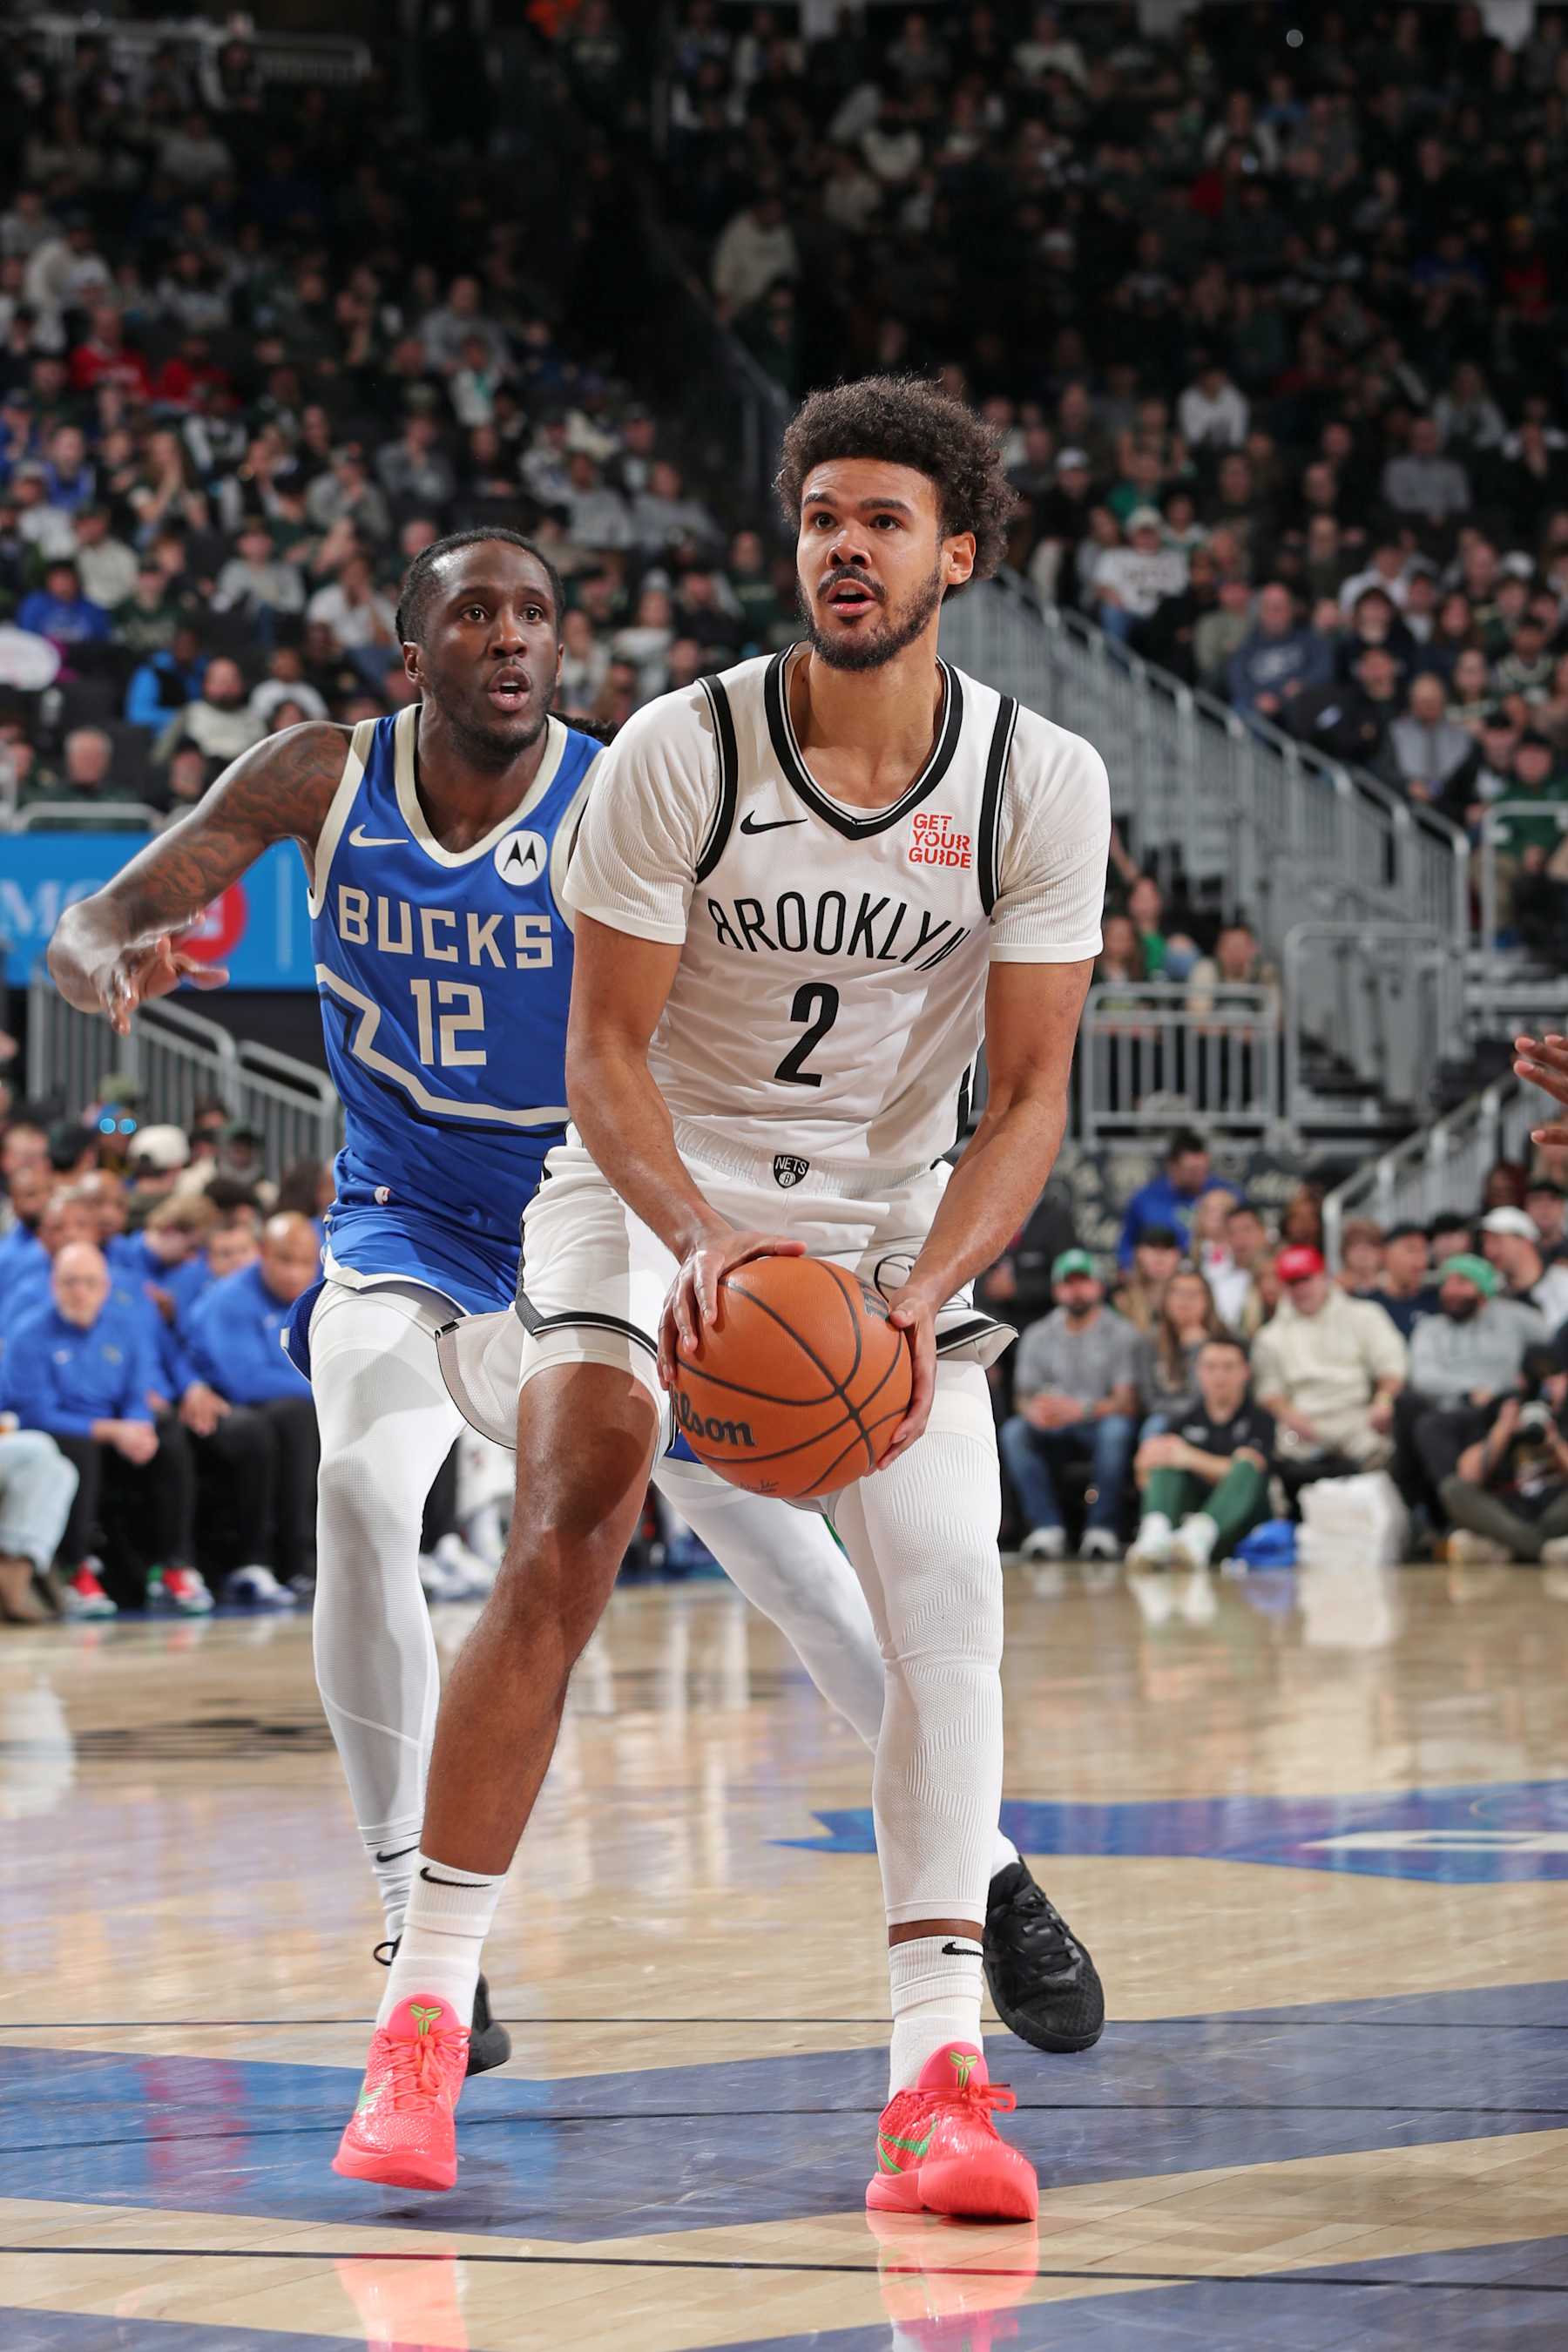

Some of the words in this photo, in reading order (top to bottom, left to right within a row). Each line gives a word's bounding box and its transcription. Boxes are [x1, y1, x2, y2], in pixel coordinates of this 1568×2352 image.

[913, 813, 953, 832] GET
[912, 829, 971, 851] YOUR
[908, 847, 972, 869] GUIDE
[338, 884, 554, 970] BUCKS
[409, 978, 488, 1067] 12
[774, 982, 841, 1088] 2
[774, 1156, 808, 1176] NETS
